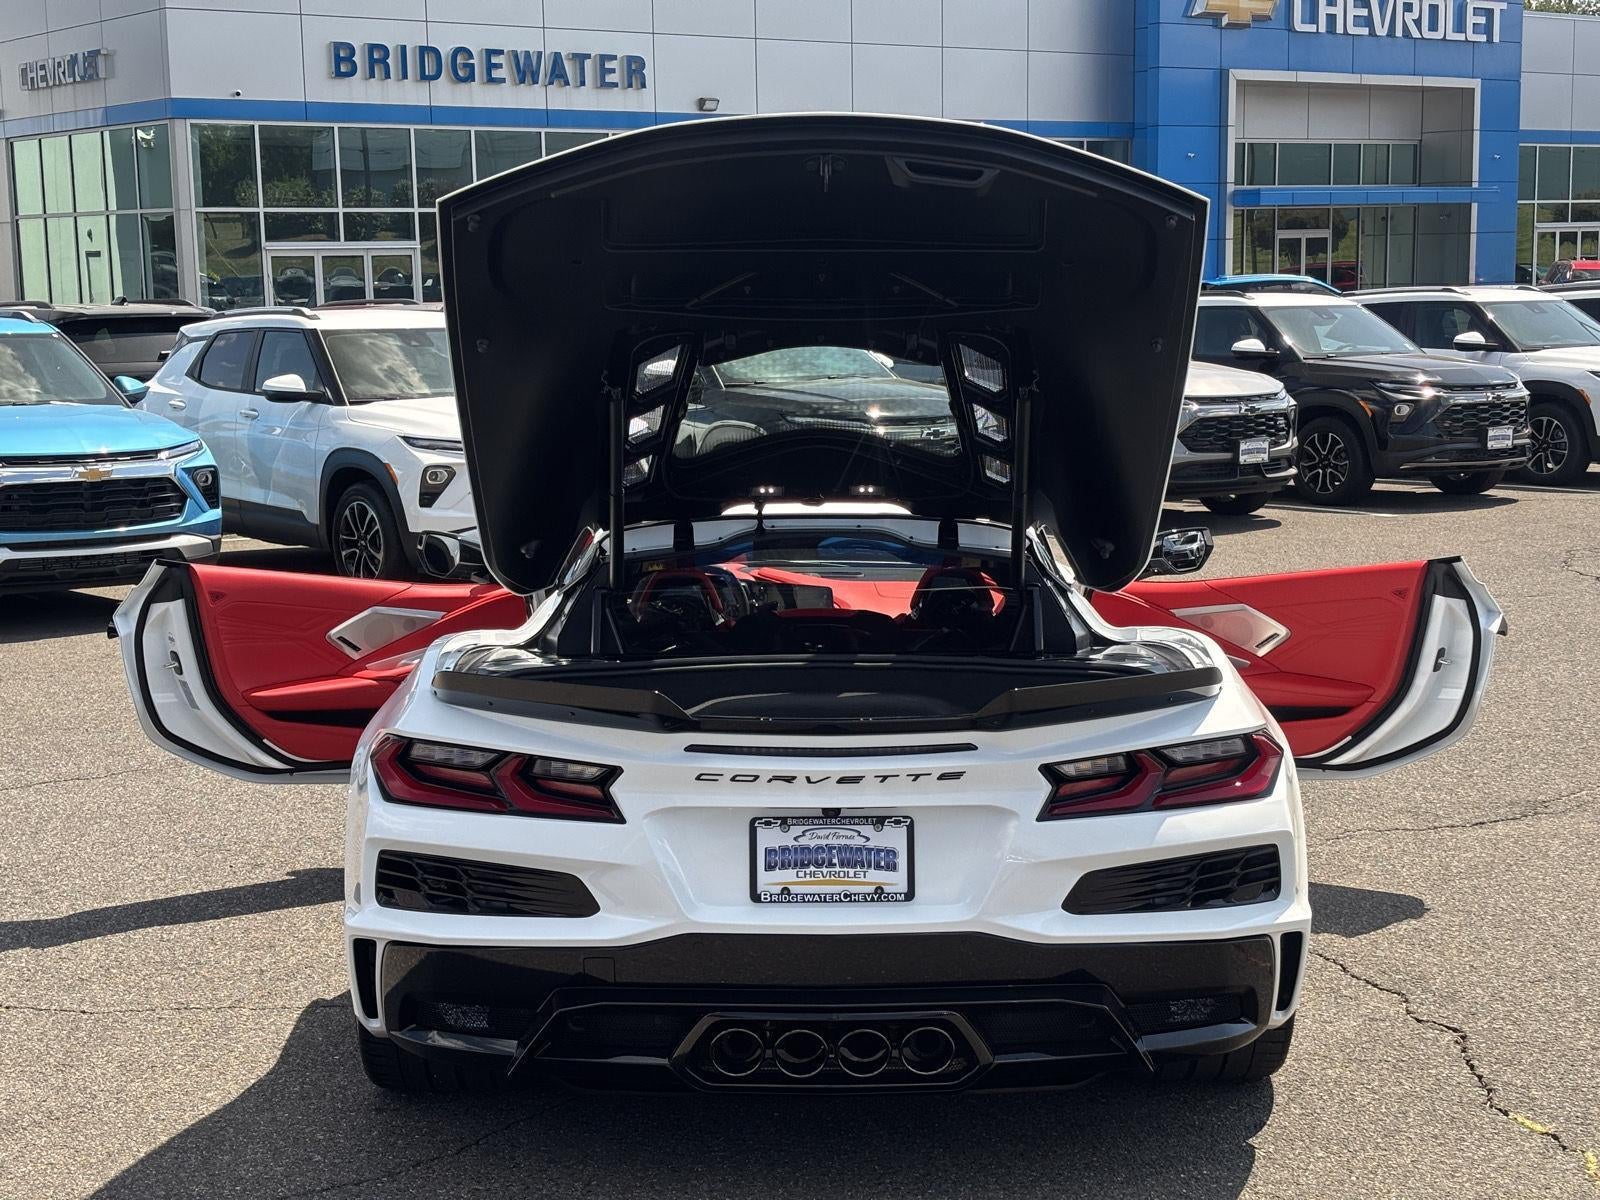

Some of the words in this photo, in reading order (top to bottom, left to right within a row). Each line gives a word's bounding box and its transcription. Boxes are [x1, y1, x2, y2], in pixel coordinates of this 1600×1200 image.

[1293, 0, 1508, 43] CHEVROLET
[330, 41, 647, 89] BRIDGEWATER
[694, 771, 967, 785] CORVETTE
[808, 832, 831, 840] David
[764, 843, 898, 872] BRIDGEWATER
[796, 870, 868, 879] CHEVROLET
[761, 890, 905, 903] BRIDGEWATERCHEVY.COM
